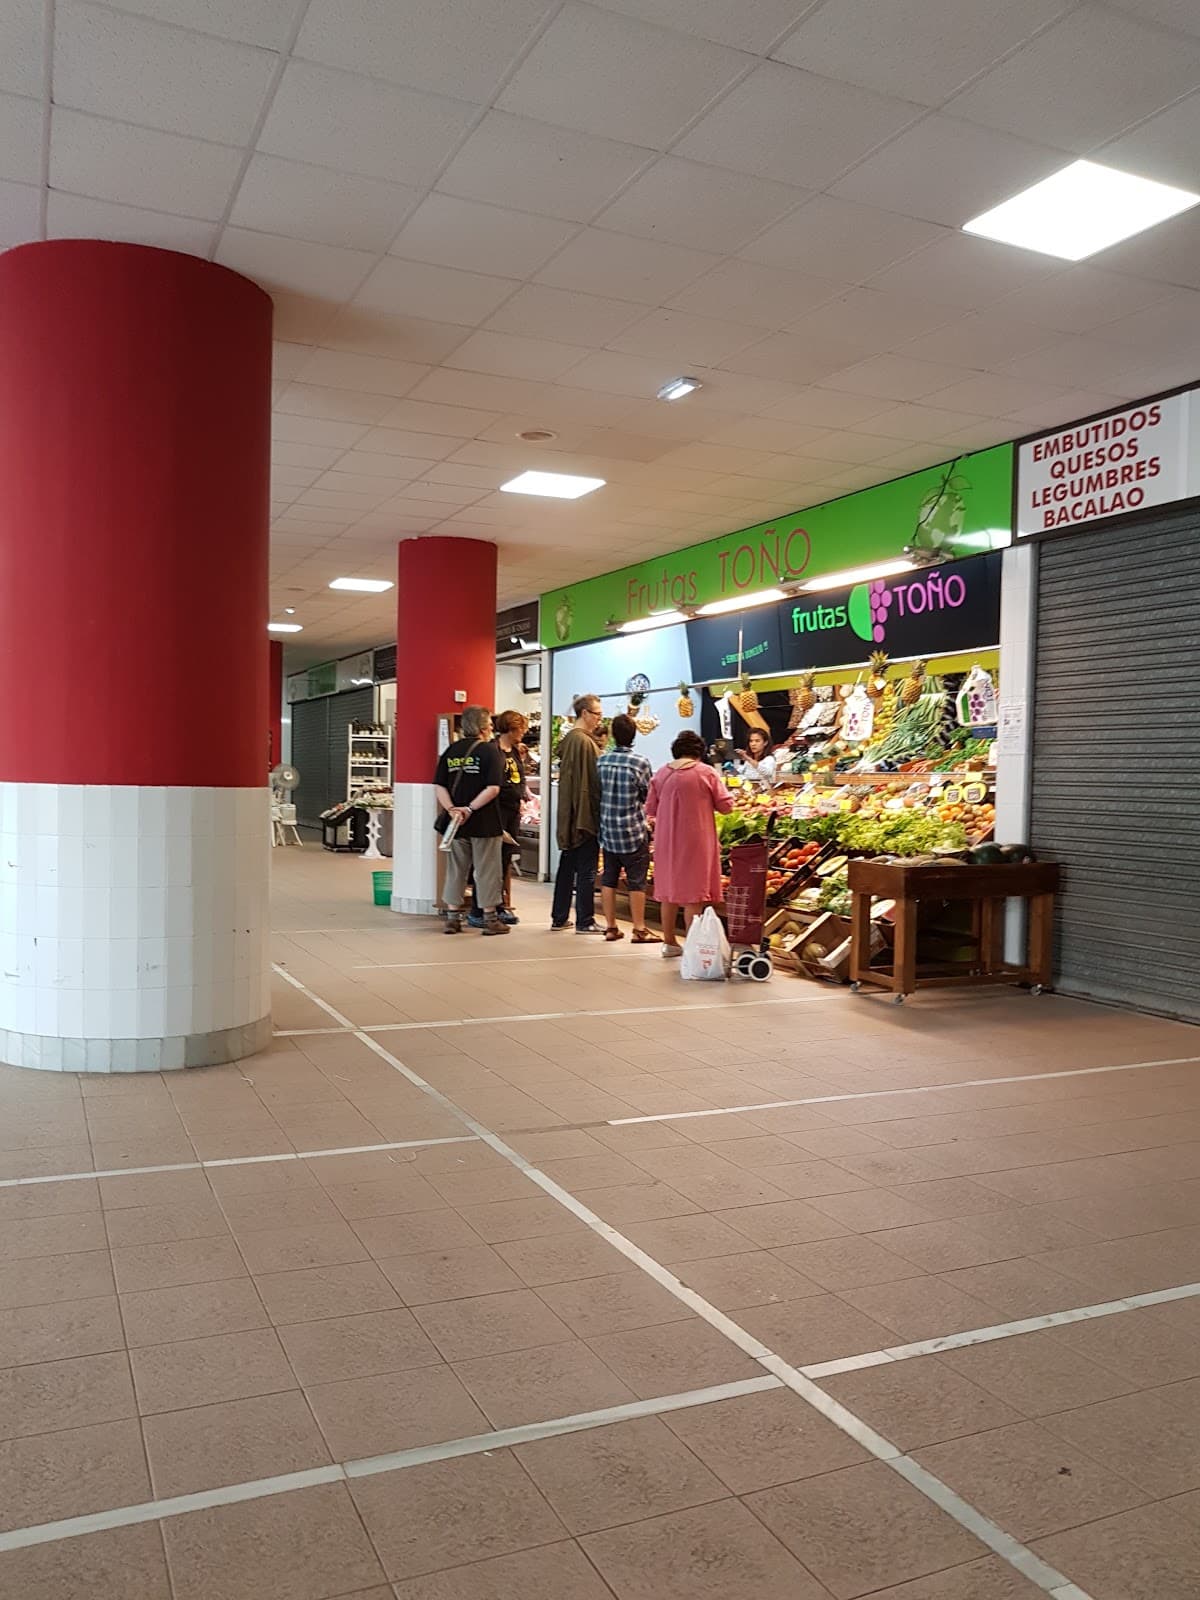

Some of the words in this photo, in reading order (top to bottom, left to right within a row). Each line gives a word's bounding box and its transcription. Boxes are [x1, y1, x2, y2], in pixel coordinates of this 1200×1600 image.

[1032, 405, 1162, 463] EMBUTIDOS
[1050, 438, 1138, 479] QUESOS
[1031, 457, 1161, 508] LEGUMBRES
[1043, 487, 1144, 528] BACALAO
[626, 569, 698, 614] Frutas
[718, 528, 811, 592] TOÑO
[792, 605, 848, 634] frutas
[893, 571, 966, 616] TOÑO
